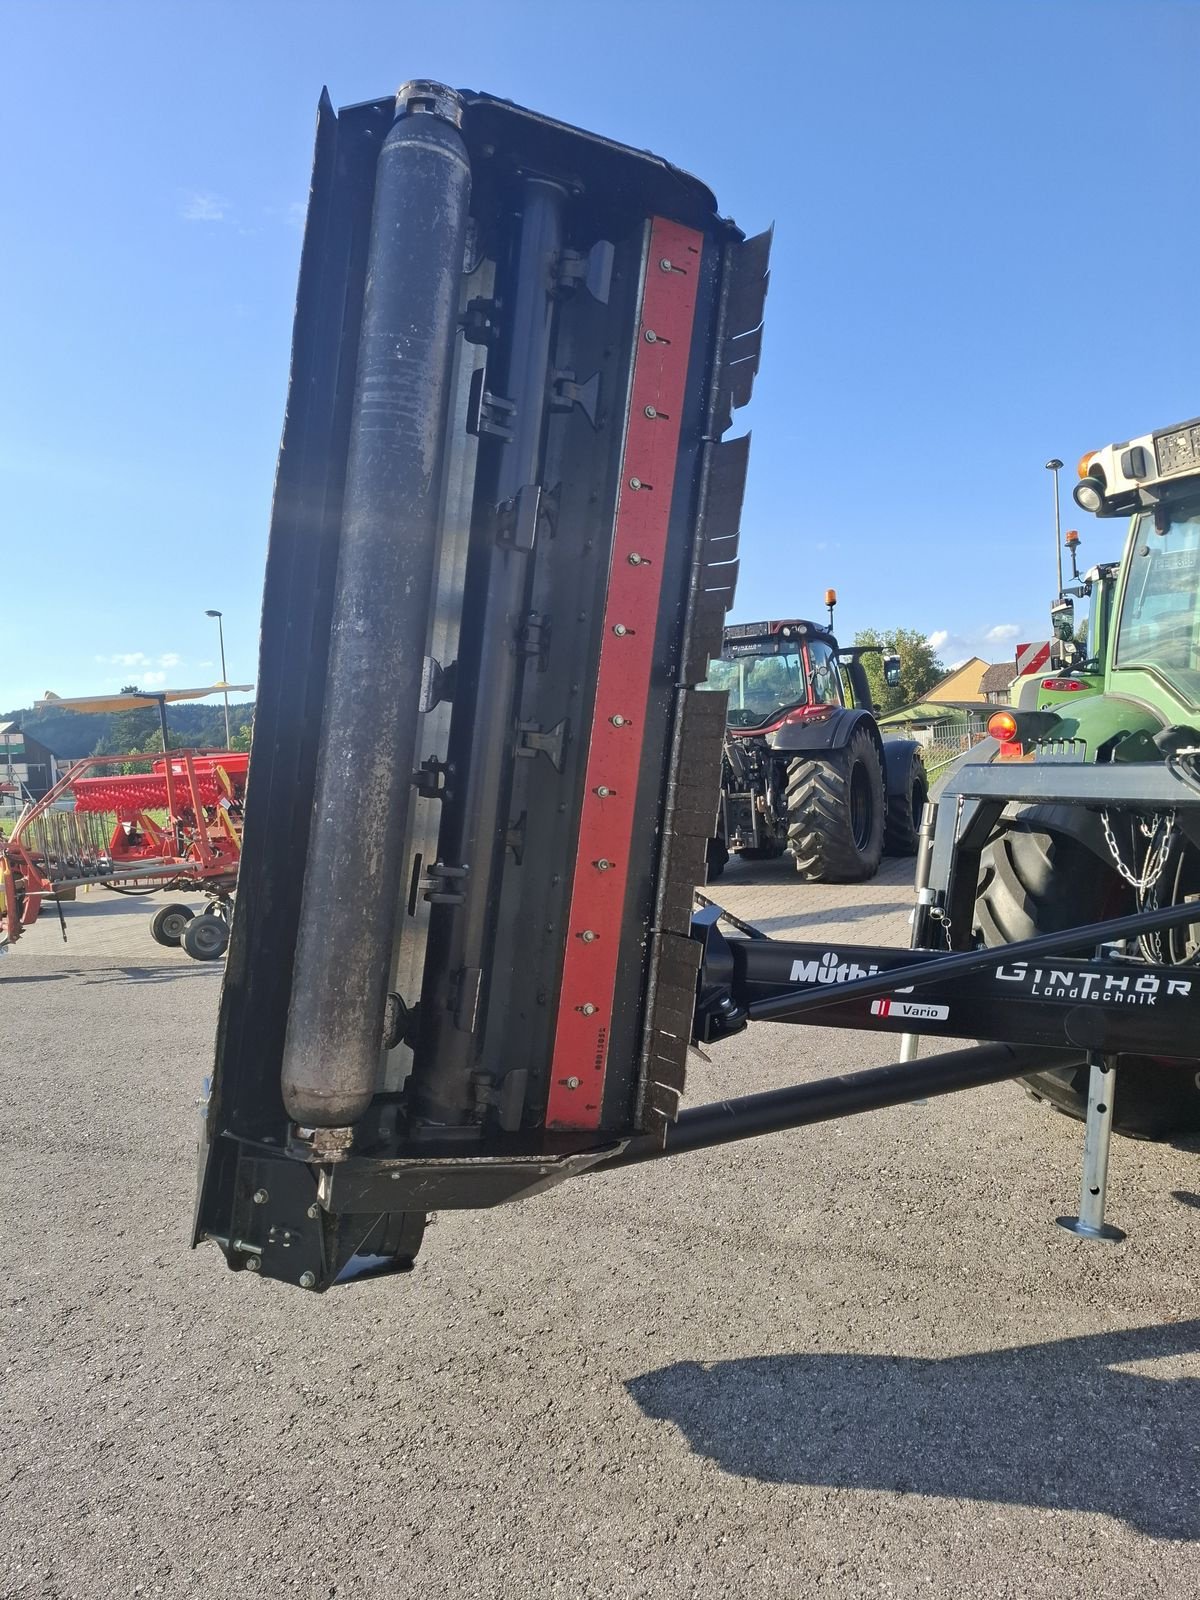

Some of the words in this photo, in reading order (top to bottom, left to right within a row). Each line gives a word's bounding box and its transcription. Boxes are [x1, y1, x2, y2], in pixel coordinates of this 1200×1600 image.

[789, 952, 915, 994] Müthi
[995, 961, 1192, 999] GINTHÖR
[902, 1004, 939, 1018] Vario
